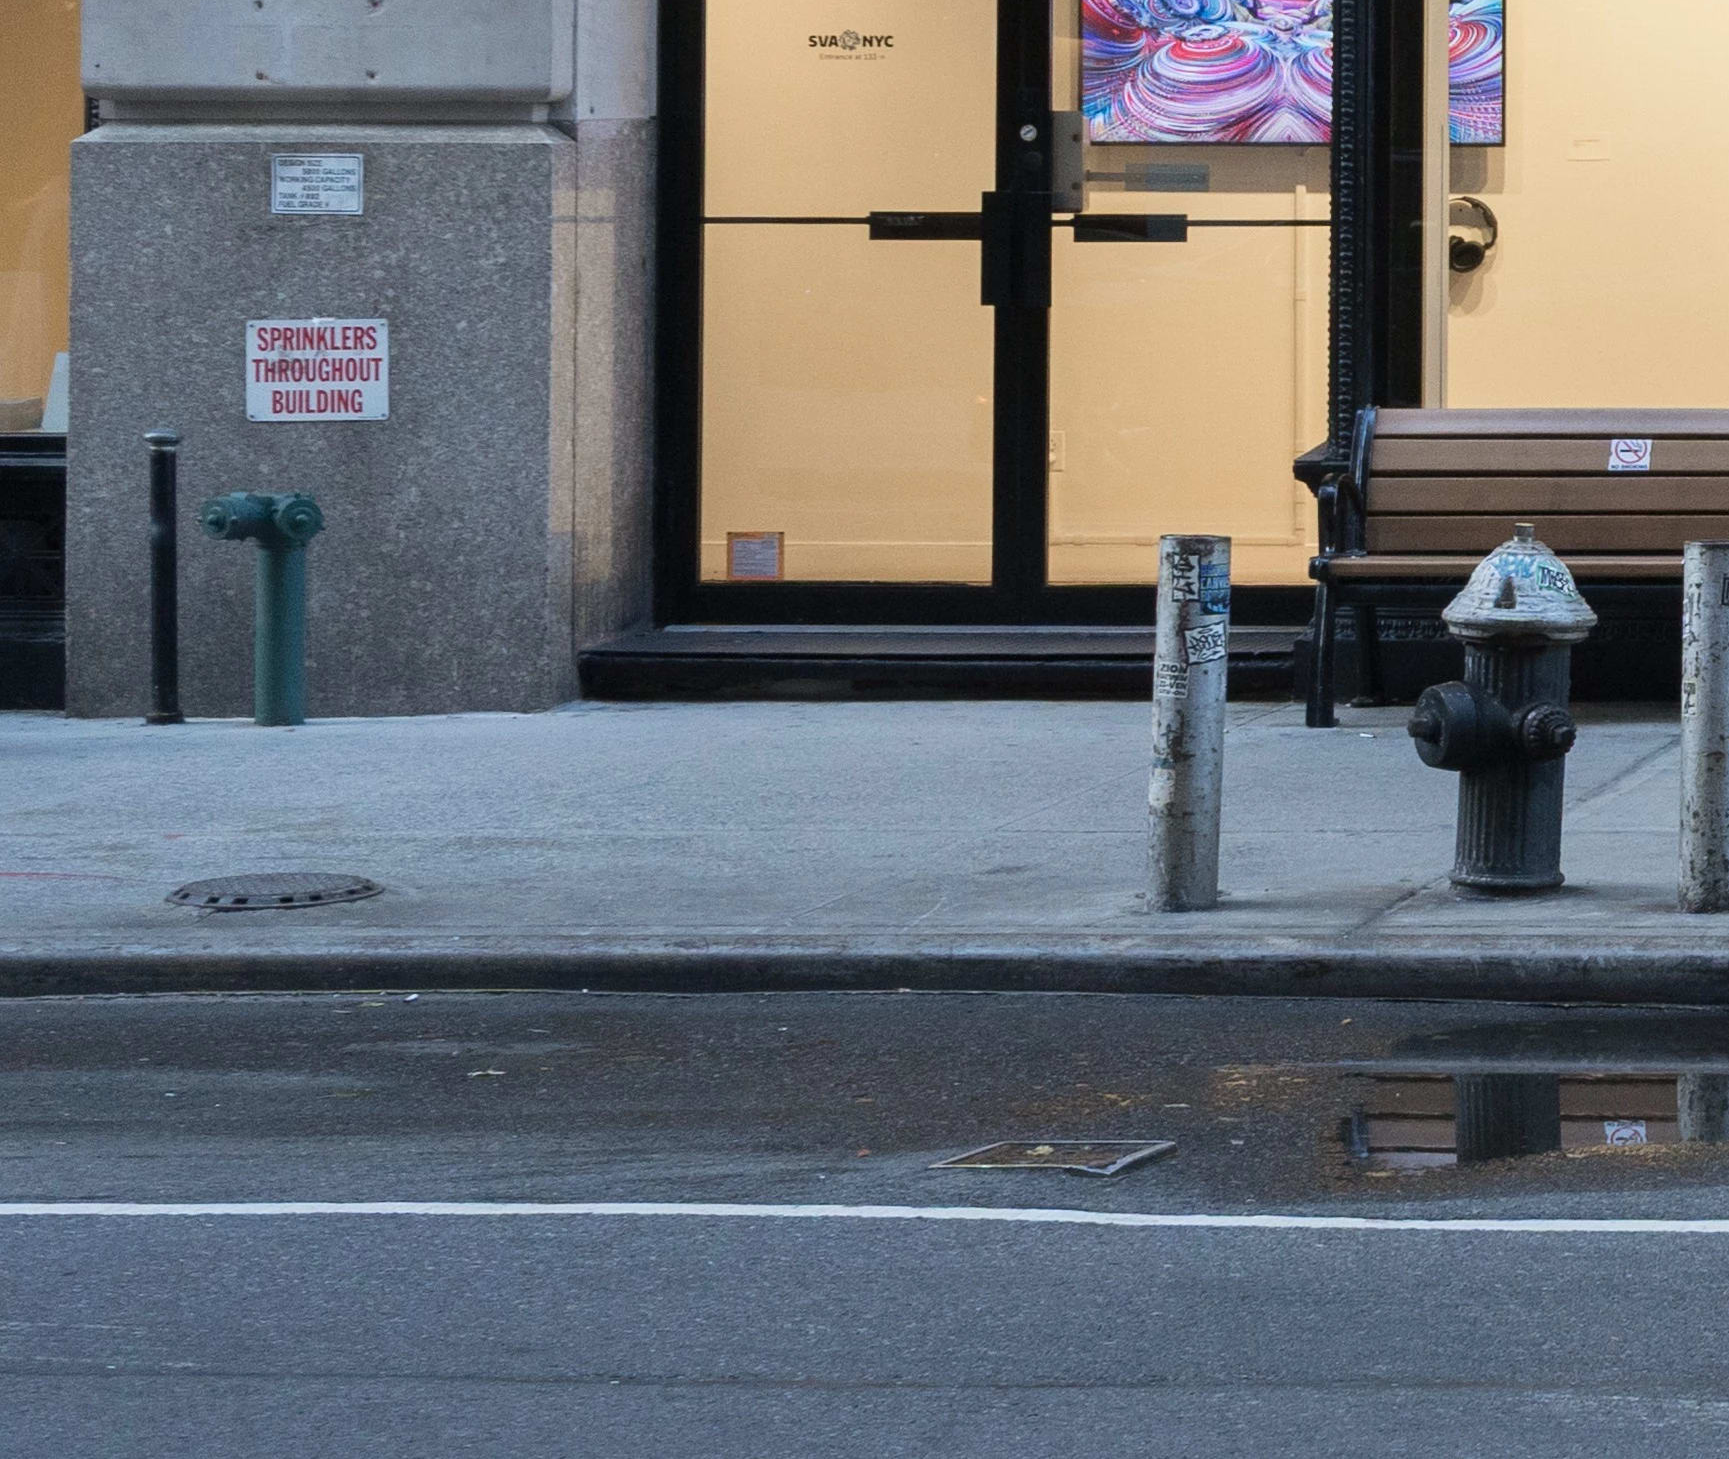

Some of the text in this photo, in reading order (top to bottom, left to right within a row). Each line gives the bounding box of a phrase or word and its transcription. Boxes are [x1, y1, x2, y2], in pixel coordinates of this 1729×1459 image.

[808, 35, 894, 48] SVA NYC
[257, 326, 377, 352] SPRINKLERS
[252, 358, 382, 383] THROUGHOUT
[272, 389, 363, 414] BUILDING
